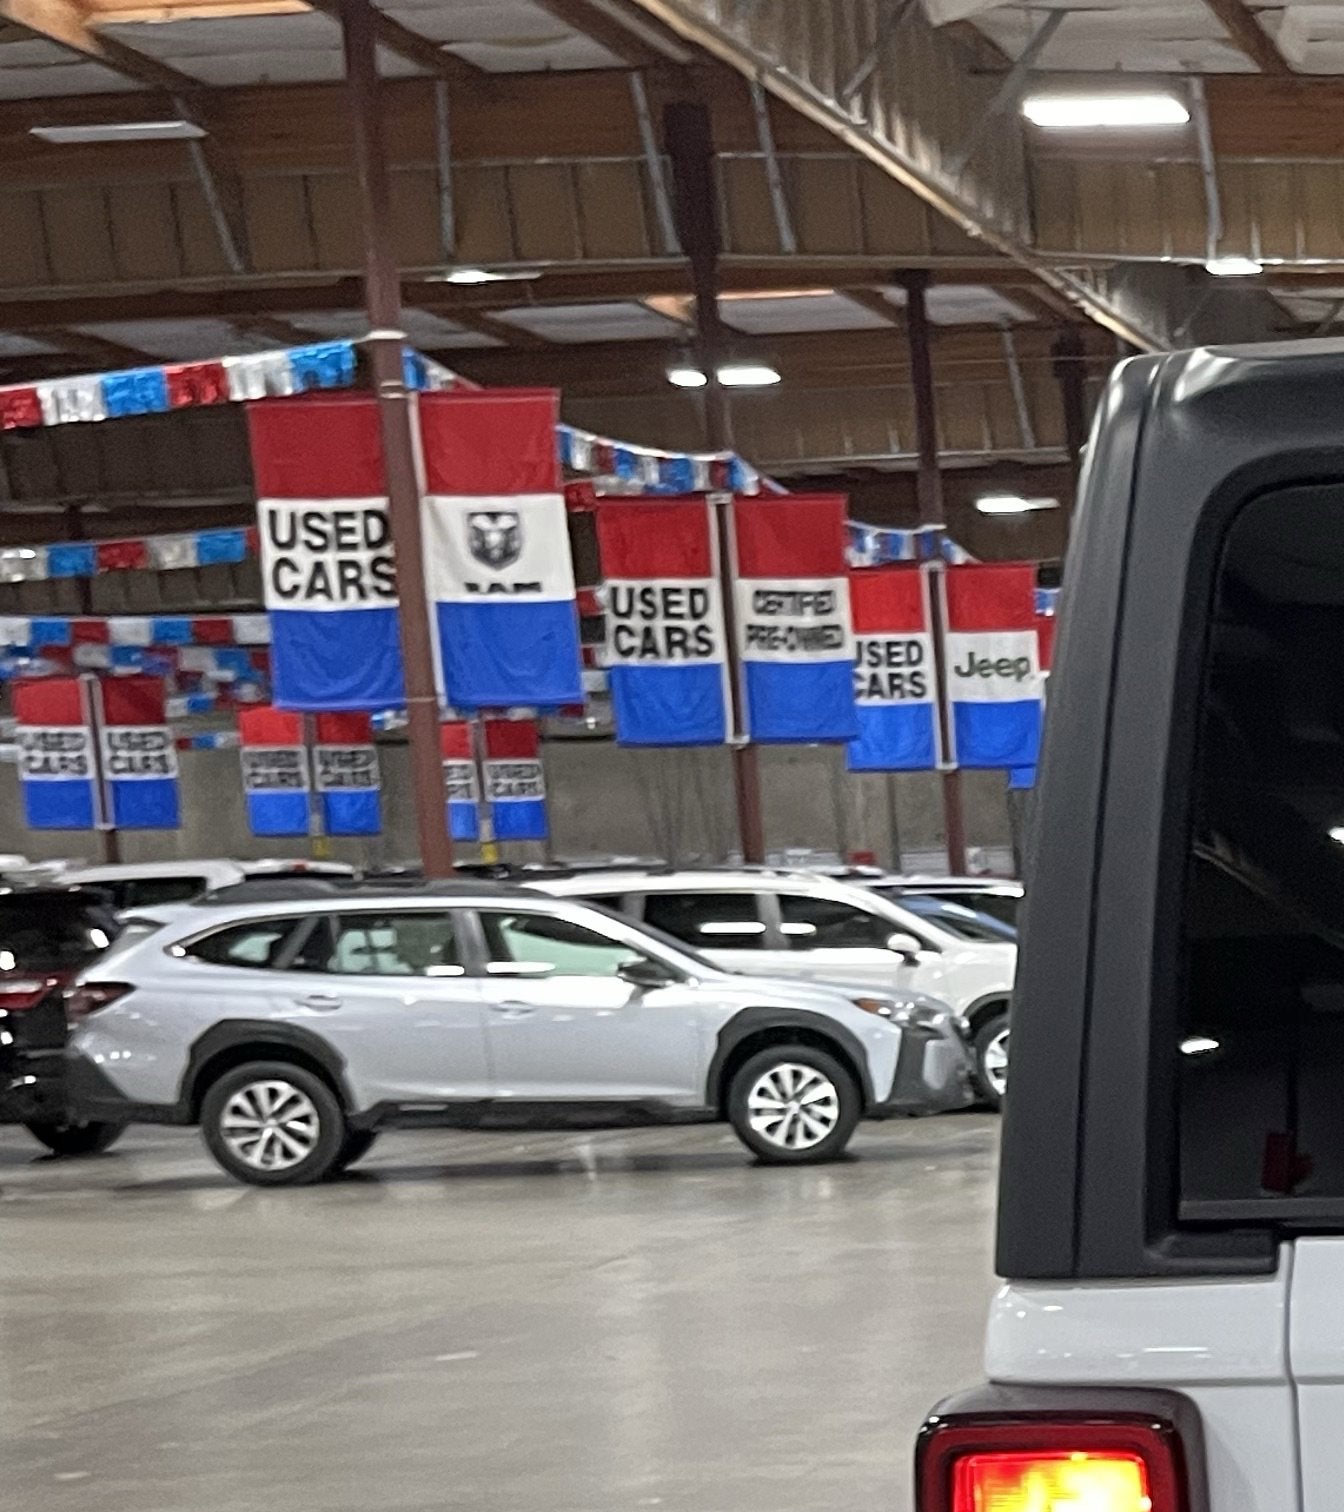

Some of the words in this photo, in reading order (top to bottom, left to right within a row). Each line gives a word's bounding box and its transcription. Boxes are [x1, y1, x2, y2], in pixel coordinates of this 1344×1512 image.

[269, 509, 390, 552] USED
[272, 556, 396, 600] CARS
[610, 586, 709, 620] USED
[614, 624, 715, 659] CARS
[954, 651, 1030, 681] Jeep
